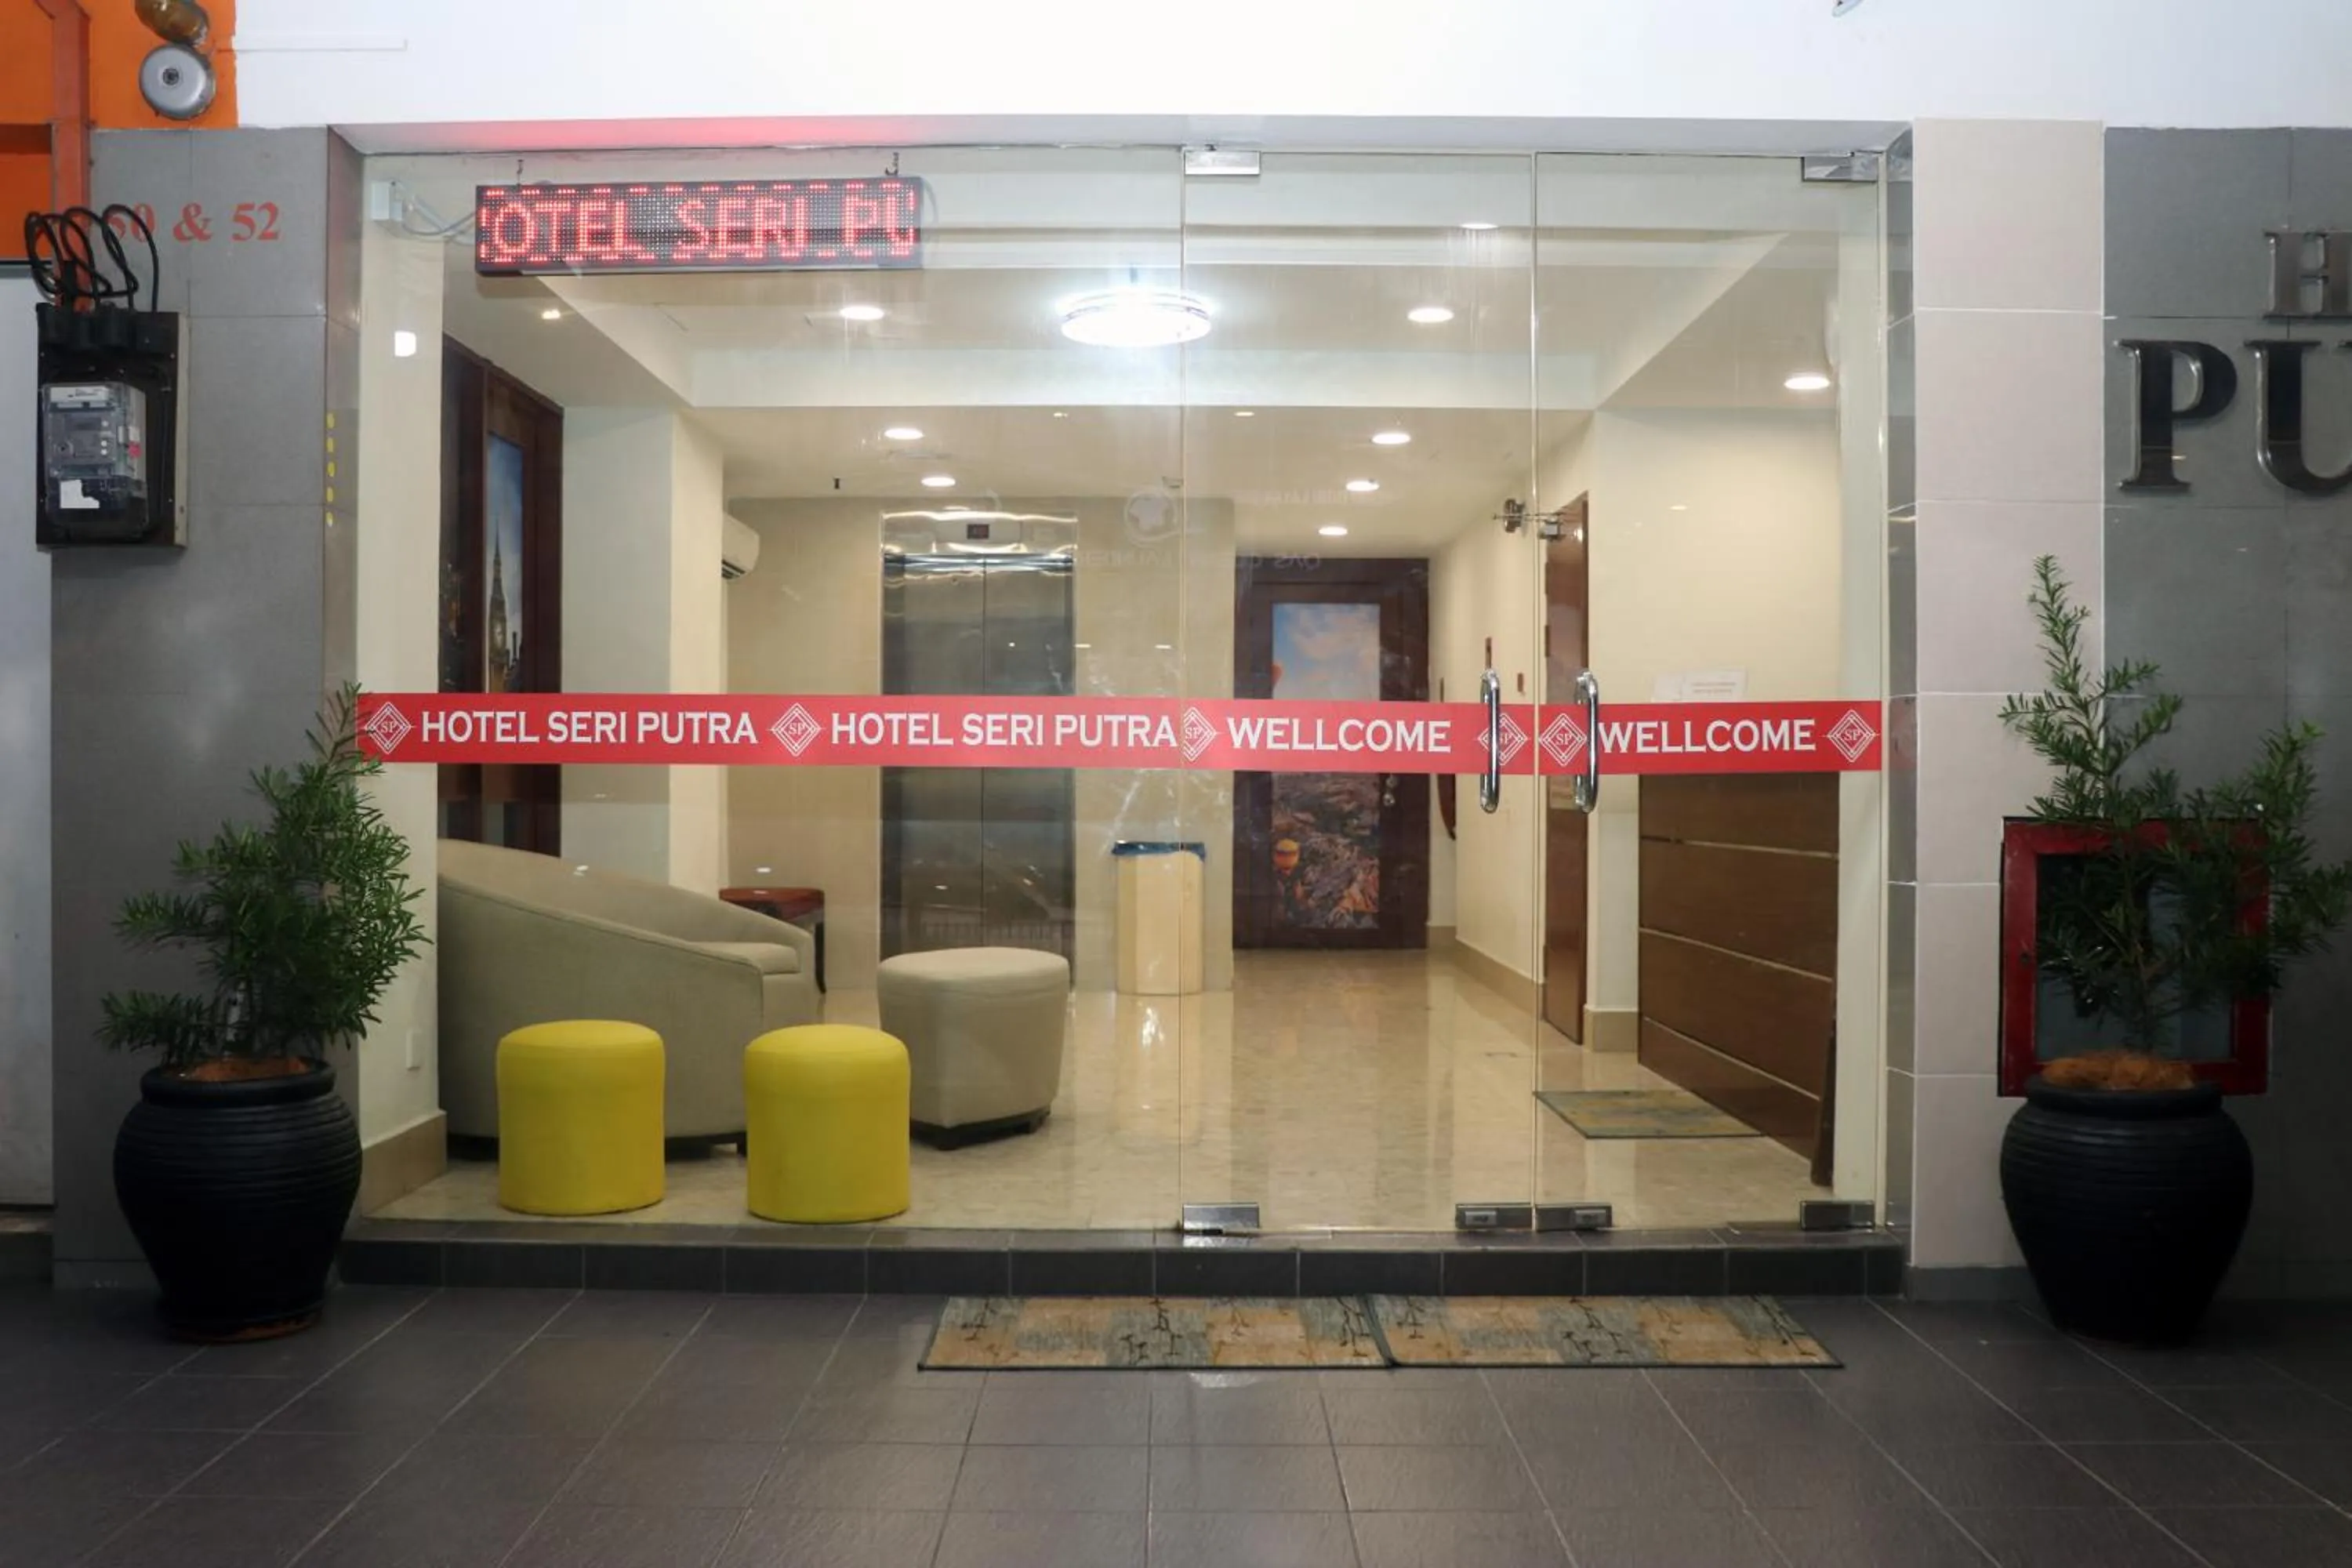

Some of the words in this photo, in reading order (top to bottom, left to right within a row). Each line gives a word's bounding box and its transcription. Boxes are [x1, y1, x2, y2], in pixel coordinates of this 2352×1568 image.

[172, 202, 213, 244] &
[231, 201, 281, 242] 52
[422, 710, 540, 744] HOTEL
[546, 711, 627, 744] SERI
[637, 711, 758, 745] PUTRA
[831, 713, 954, 746] HOTEL
[962, 713, 1044, 746] SERI
[1054, 714, 1178, 747] PUTRA
[1226, 717, 1452, 753] WELLCOME
[1597, 719, 1817, 754] WELLCOME
